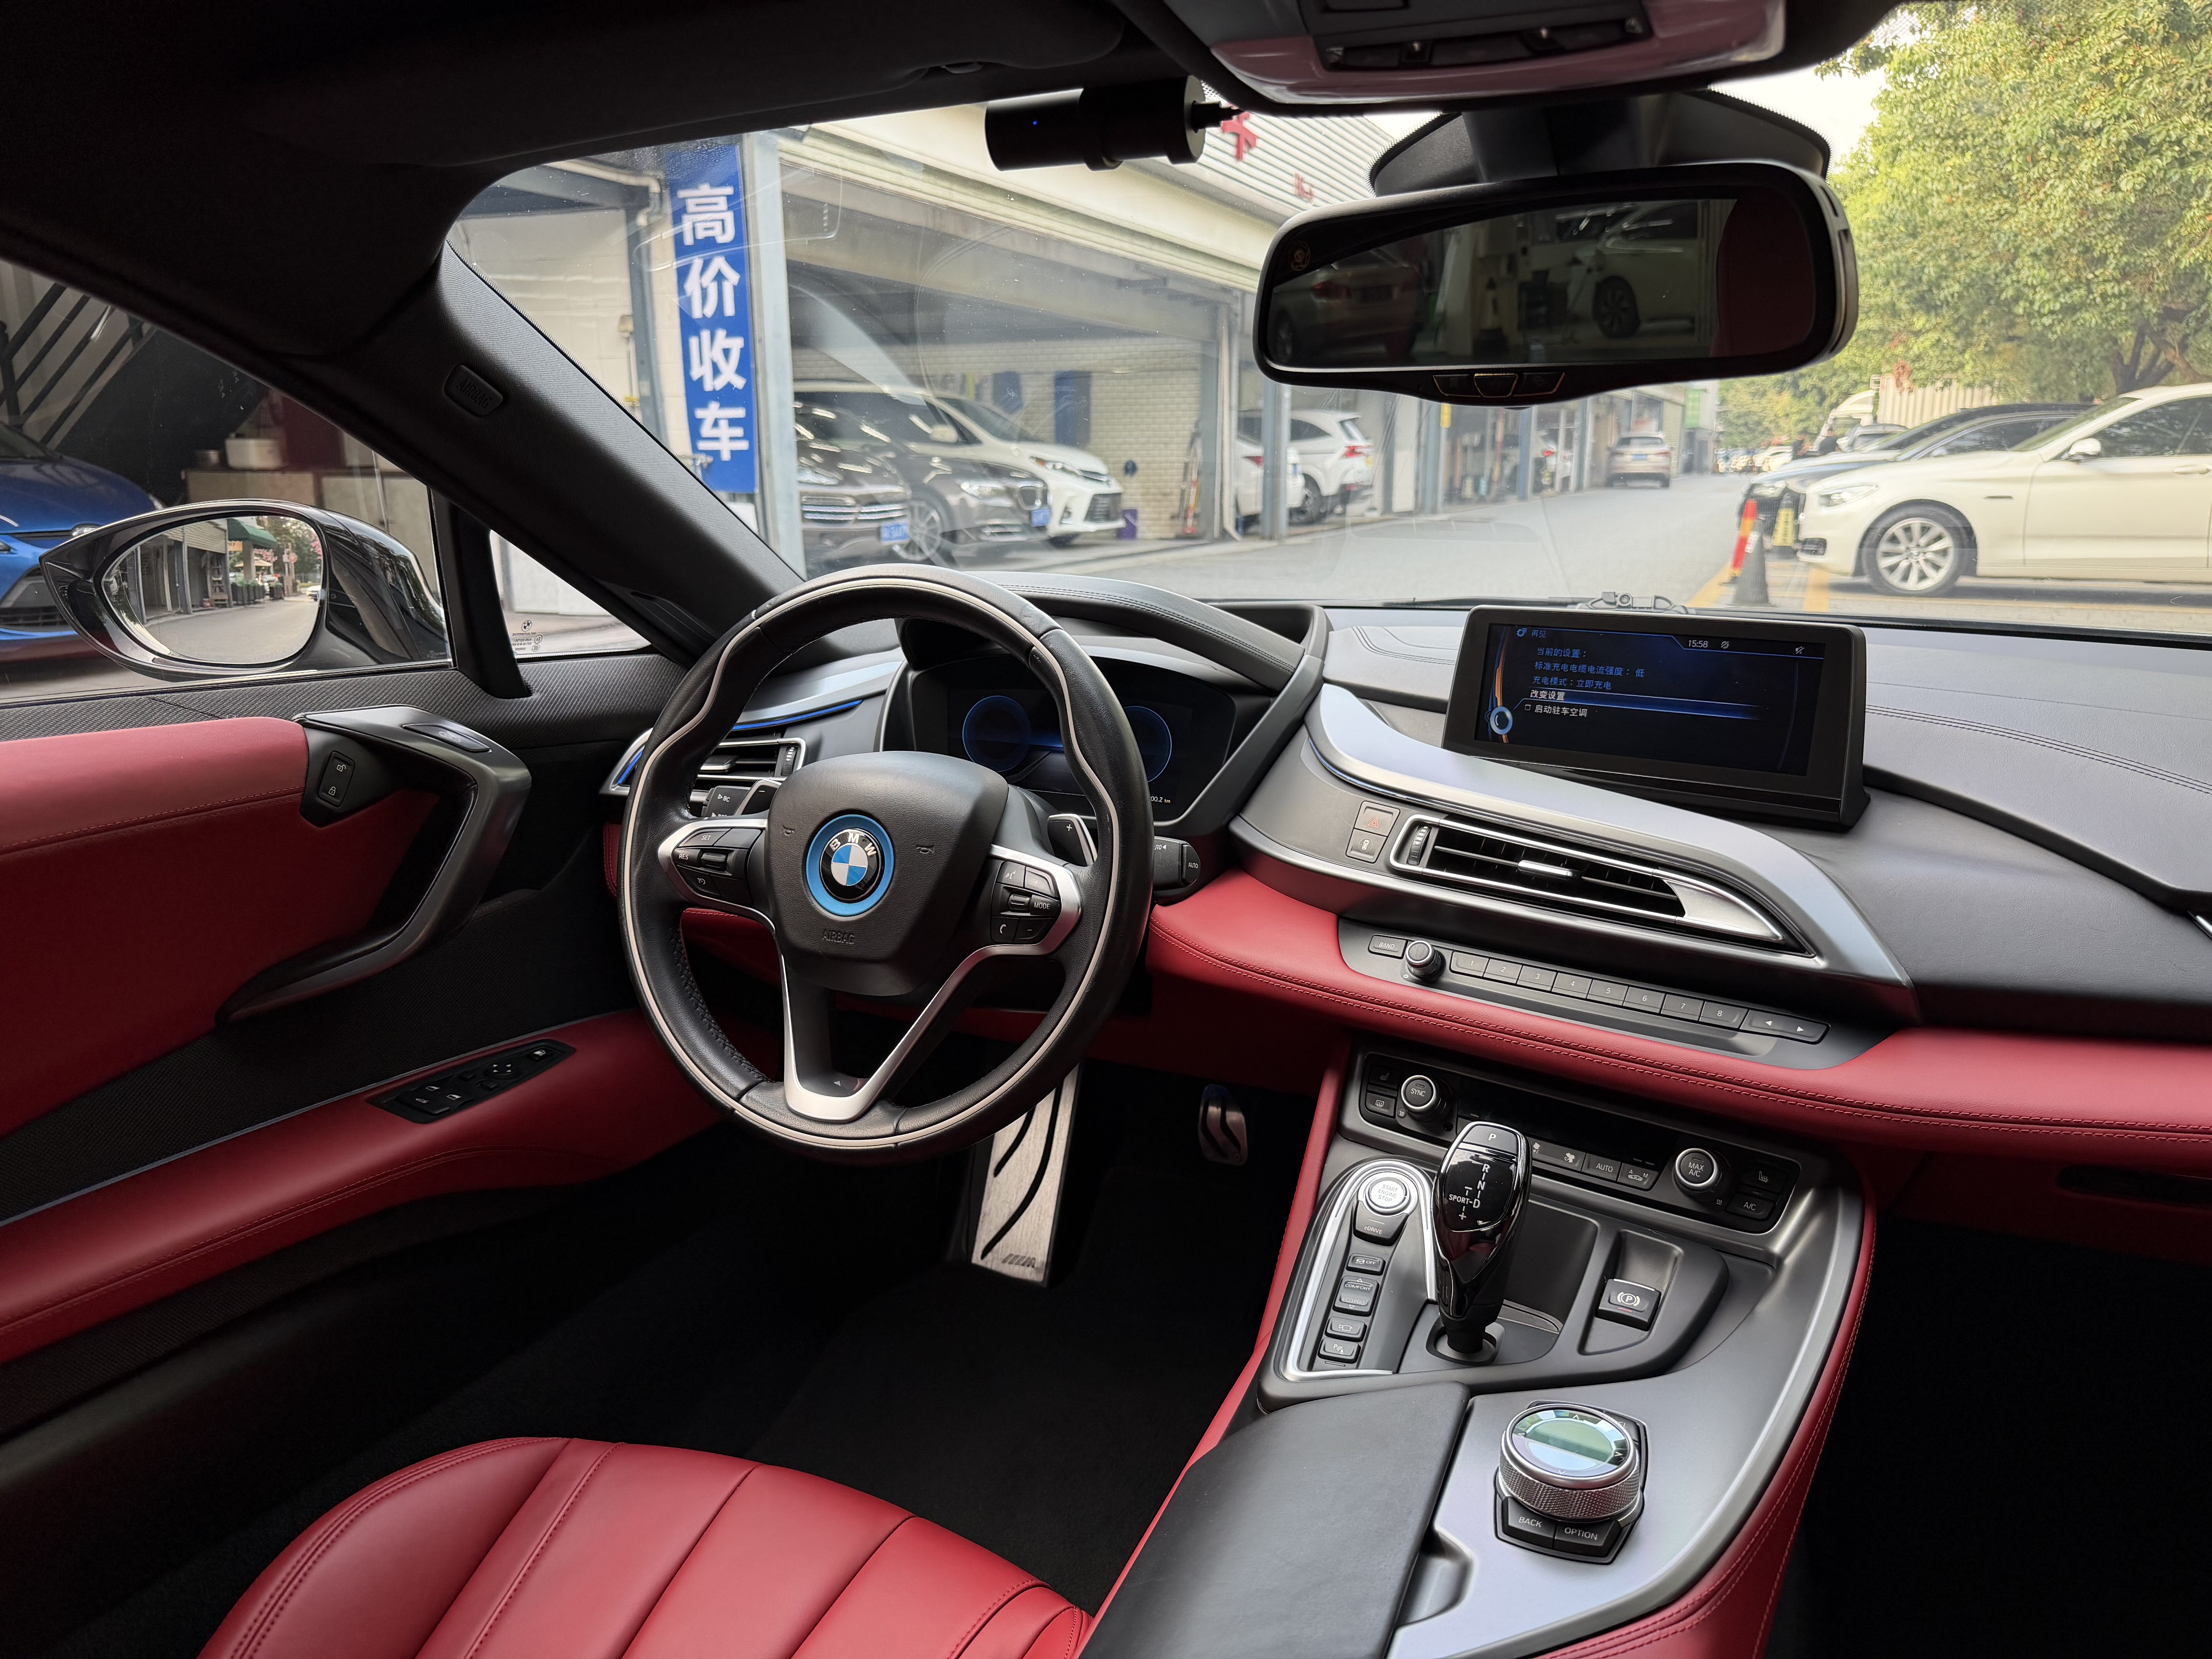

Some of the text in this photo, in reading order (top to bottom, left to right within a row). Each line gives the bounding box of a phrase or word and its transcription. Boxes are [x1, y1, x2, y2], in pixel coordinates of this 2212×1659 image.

[677, 184, 749, 461] 高价收车
[456, 379, 491, 409] AIRBAG
[1532, 630, 1546, 638] 再见
[1688, 639, 1708, 648] 15:58
[1530, 690, 1565, 701] 改变设置
[1534, 705, 1587, 717] 启动驻车空调
[830, 832, 876, 857] BMW
[822, 929, 855, 945] AIRBAG
[1379, 942, 1395, 950] BAND
[1410, 1088, 1425, 1097] SYNC
[1482, 1164, 1490, 1172] R
[1596, 1163, 1613, 1172] AUTO
[1688, 1162, 1704, 1171] MAX
[1688, 1169, 1701, 1177] A/C
[1477, 1181, 1484, 1190] N
[1378, 1189, 1397, 1198] ENGINE
[1743, 1202, 1756, 1211] A/C
[1364, 1226, 1383, 1235] eDRIVE
[1519, 1516, 1542, 1528] BACK
[1565, 1528, 1597, 1540] OPTION
